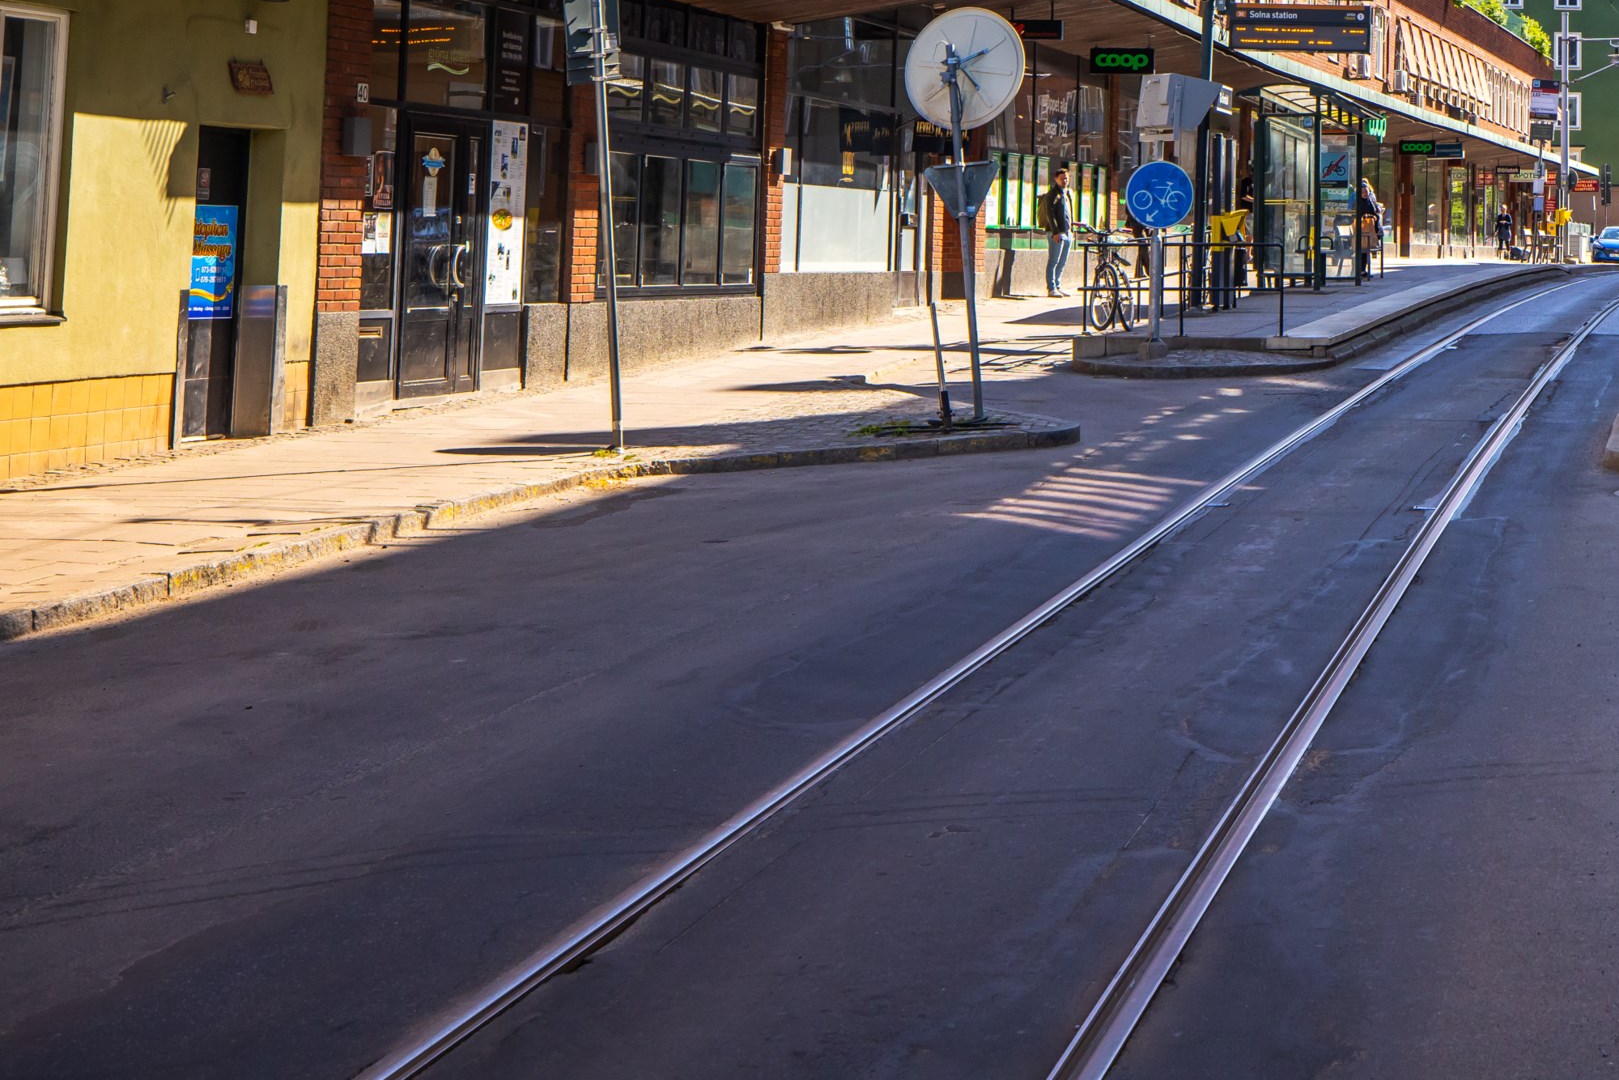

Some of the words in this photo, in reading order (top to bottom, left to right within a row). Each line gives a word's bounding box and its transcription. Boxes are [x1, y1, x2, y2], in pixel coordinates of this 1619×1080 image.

[1249, 10, 1271, 19] Solna
[1271, 11, 1298, 20] station
[1095, 53, 1149, 71] coop
[358, 85, 368, 102] 40
[1401, 142, 1433, 153] coop
